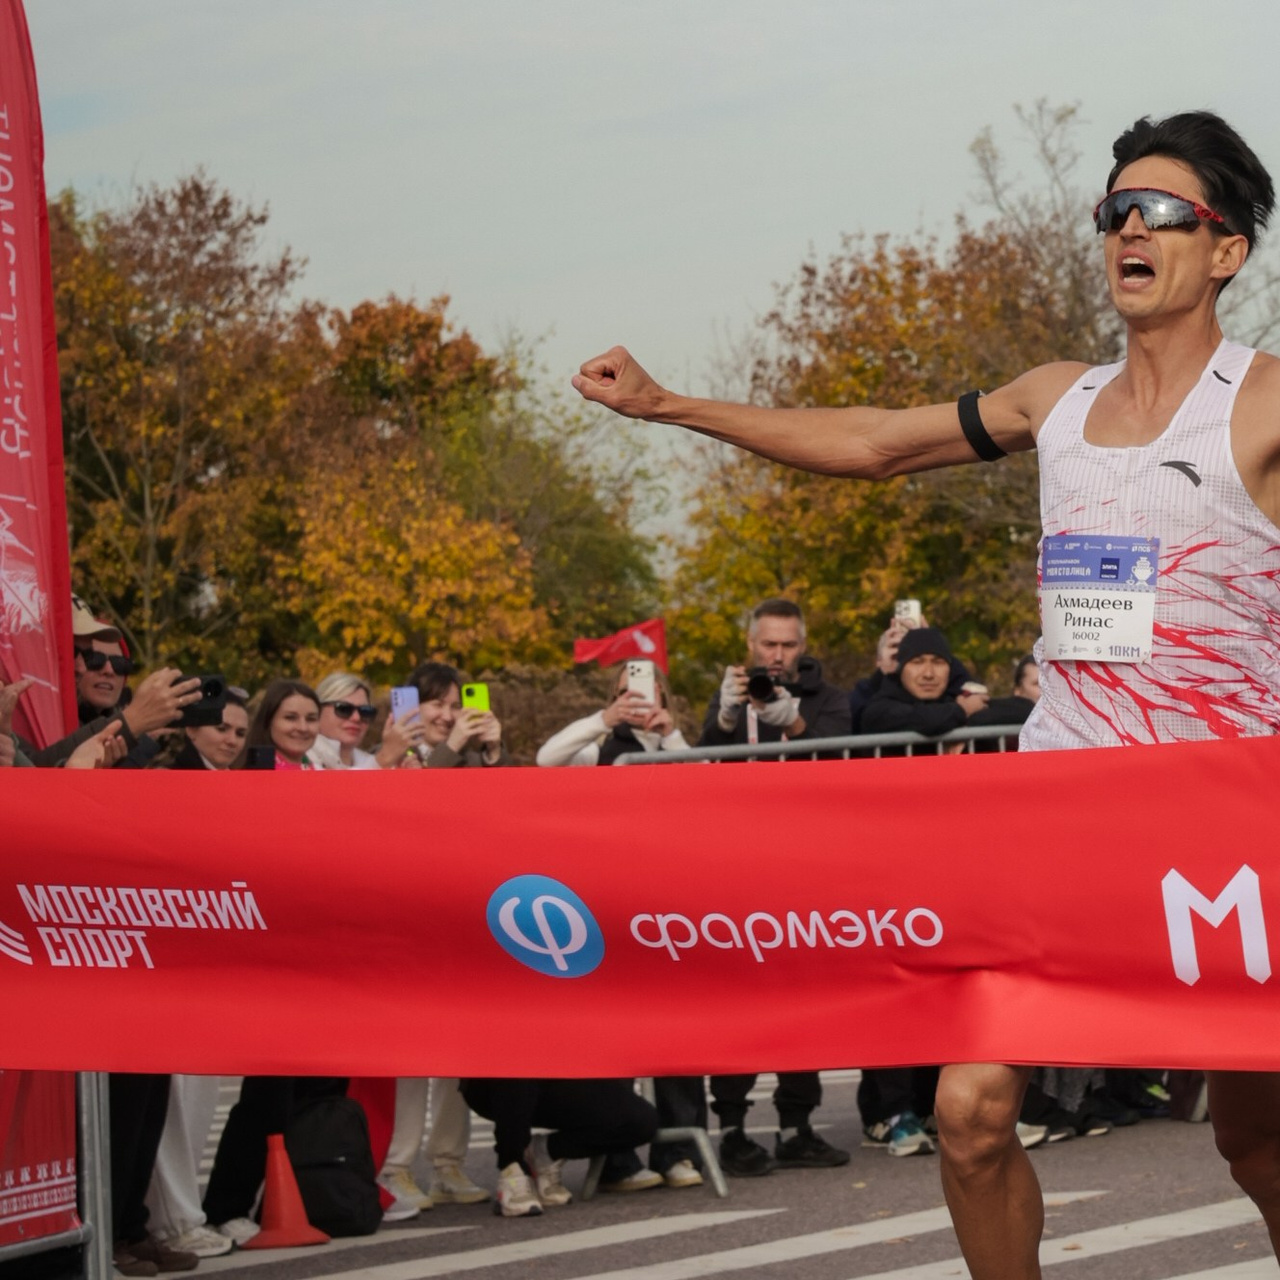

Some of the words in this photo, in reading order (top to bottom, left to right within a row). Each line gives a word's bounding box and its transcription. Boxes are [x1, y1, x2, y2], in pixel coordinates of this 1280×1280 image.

[1054, 594, 1133, 611] Ахмадеев
[1064, 612, 1114, 629] Ринас
[1072, 631, 1100, 641] 16002
[17, 881, 267, 931] МОСКОВСКИЙ
[37, 927, 154, 969] СПОРТ
